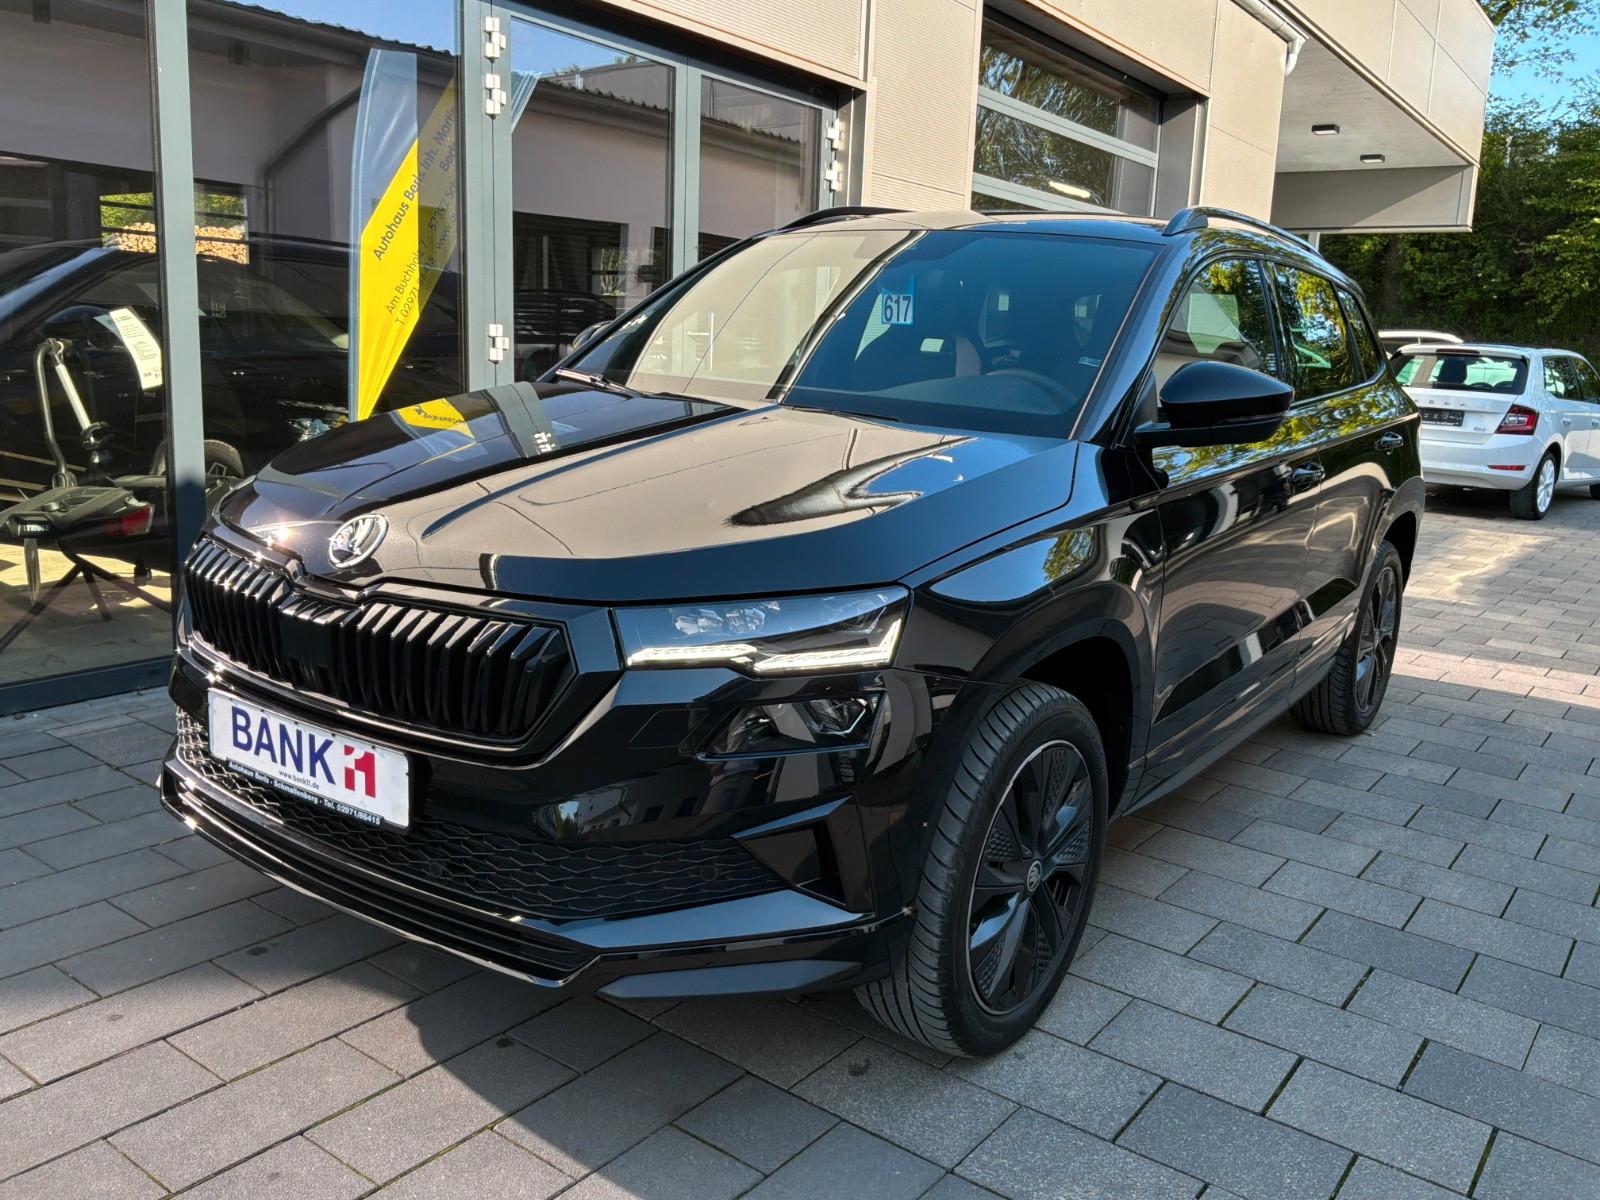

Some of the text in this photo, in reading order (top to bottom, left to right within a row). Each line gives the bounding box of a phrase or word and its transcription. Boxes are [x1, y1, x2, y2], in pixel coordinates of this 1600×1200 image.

[372, 201, 410, 261] Autohaus
[403, 170, 426, 202] Berls
[386, 293, 401, 314] Am
[884, 295, 912, 323] 617
[231, 705, 337, 786] BANK
[324, 799, 336, 810] Tel.
